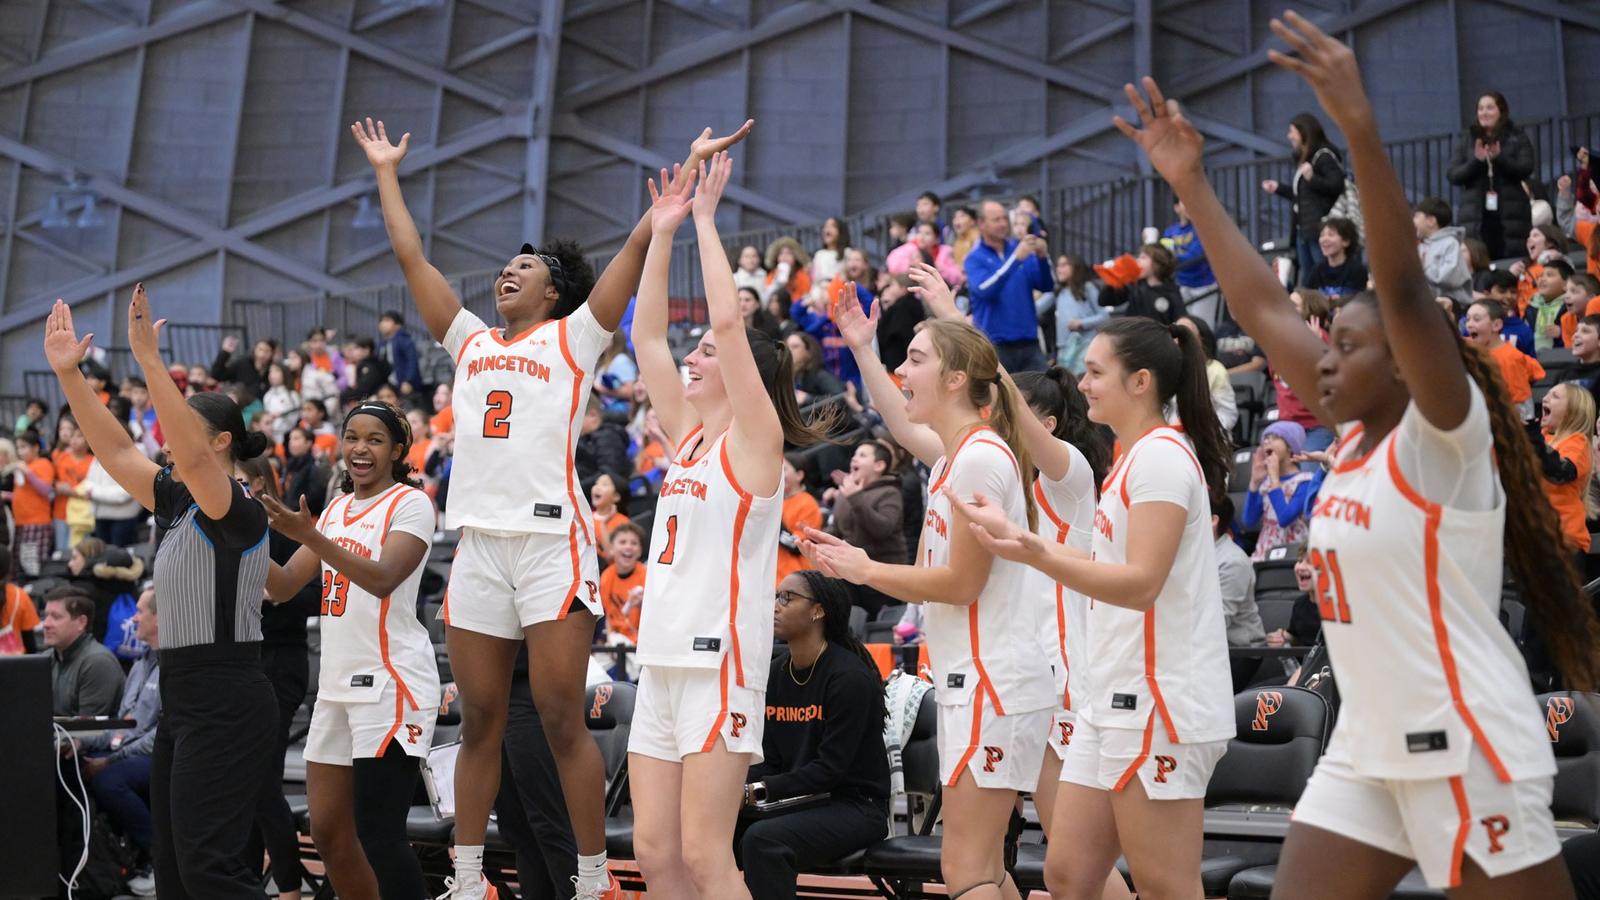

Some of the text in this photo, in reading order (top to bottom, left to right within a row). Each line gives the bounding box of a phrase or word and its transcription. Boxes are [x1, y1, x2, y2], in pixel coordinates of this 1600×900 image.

[467, 354, 551, 383] PRINCETON
[483, 389, 513, 439] 2
[657, 514, 678, 565] 1
[320, 569, 350, 617] 23
[585, 580, 598, 603] P
[1311, 547, 1352, 624] 21
[590, 684, 614, 719] P
[1252, 691, 1283, 731] P
[405, 723, 423, 745] P
[730, 711, 748, 738] P
[1058, 721, 1075, 746] P
[1546, 696, 1575, 743] P
[983, 745, 1004, 773] P
[1153, 754, 1178, 784] P
[1480, 814, 1511, 855] P
